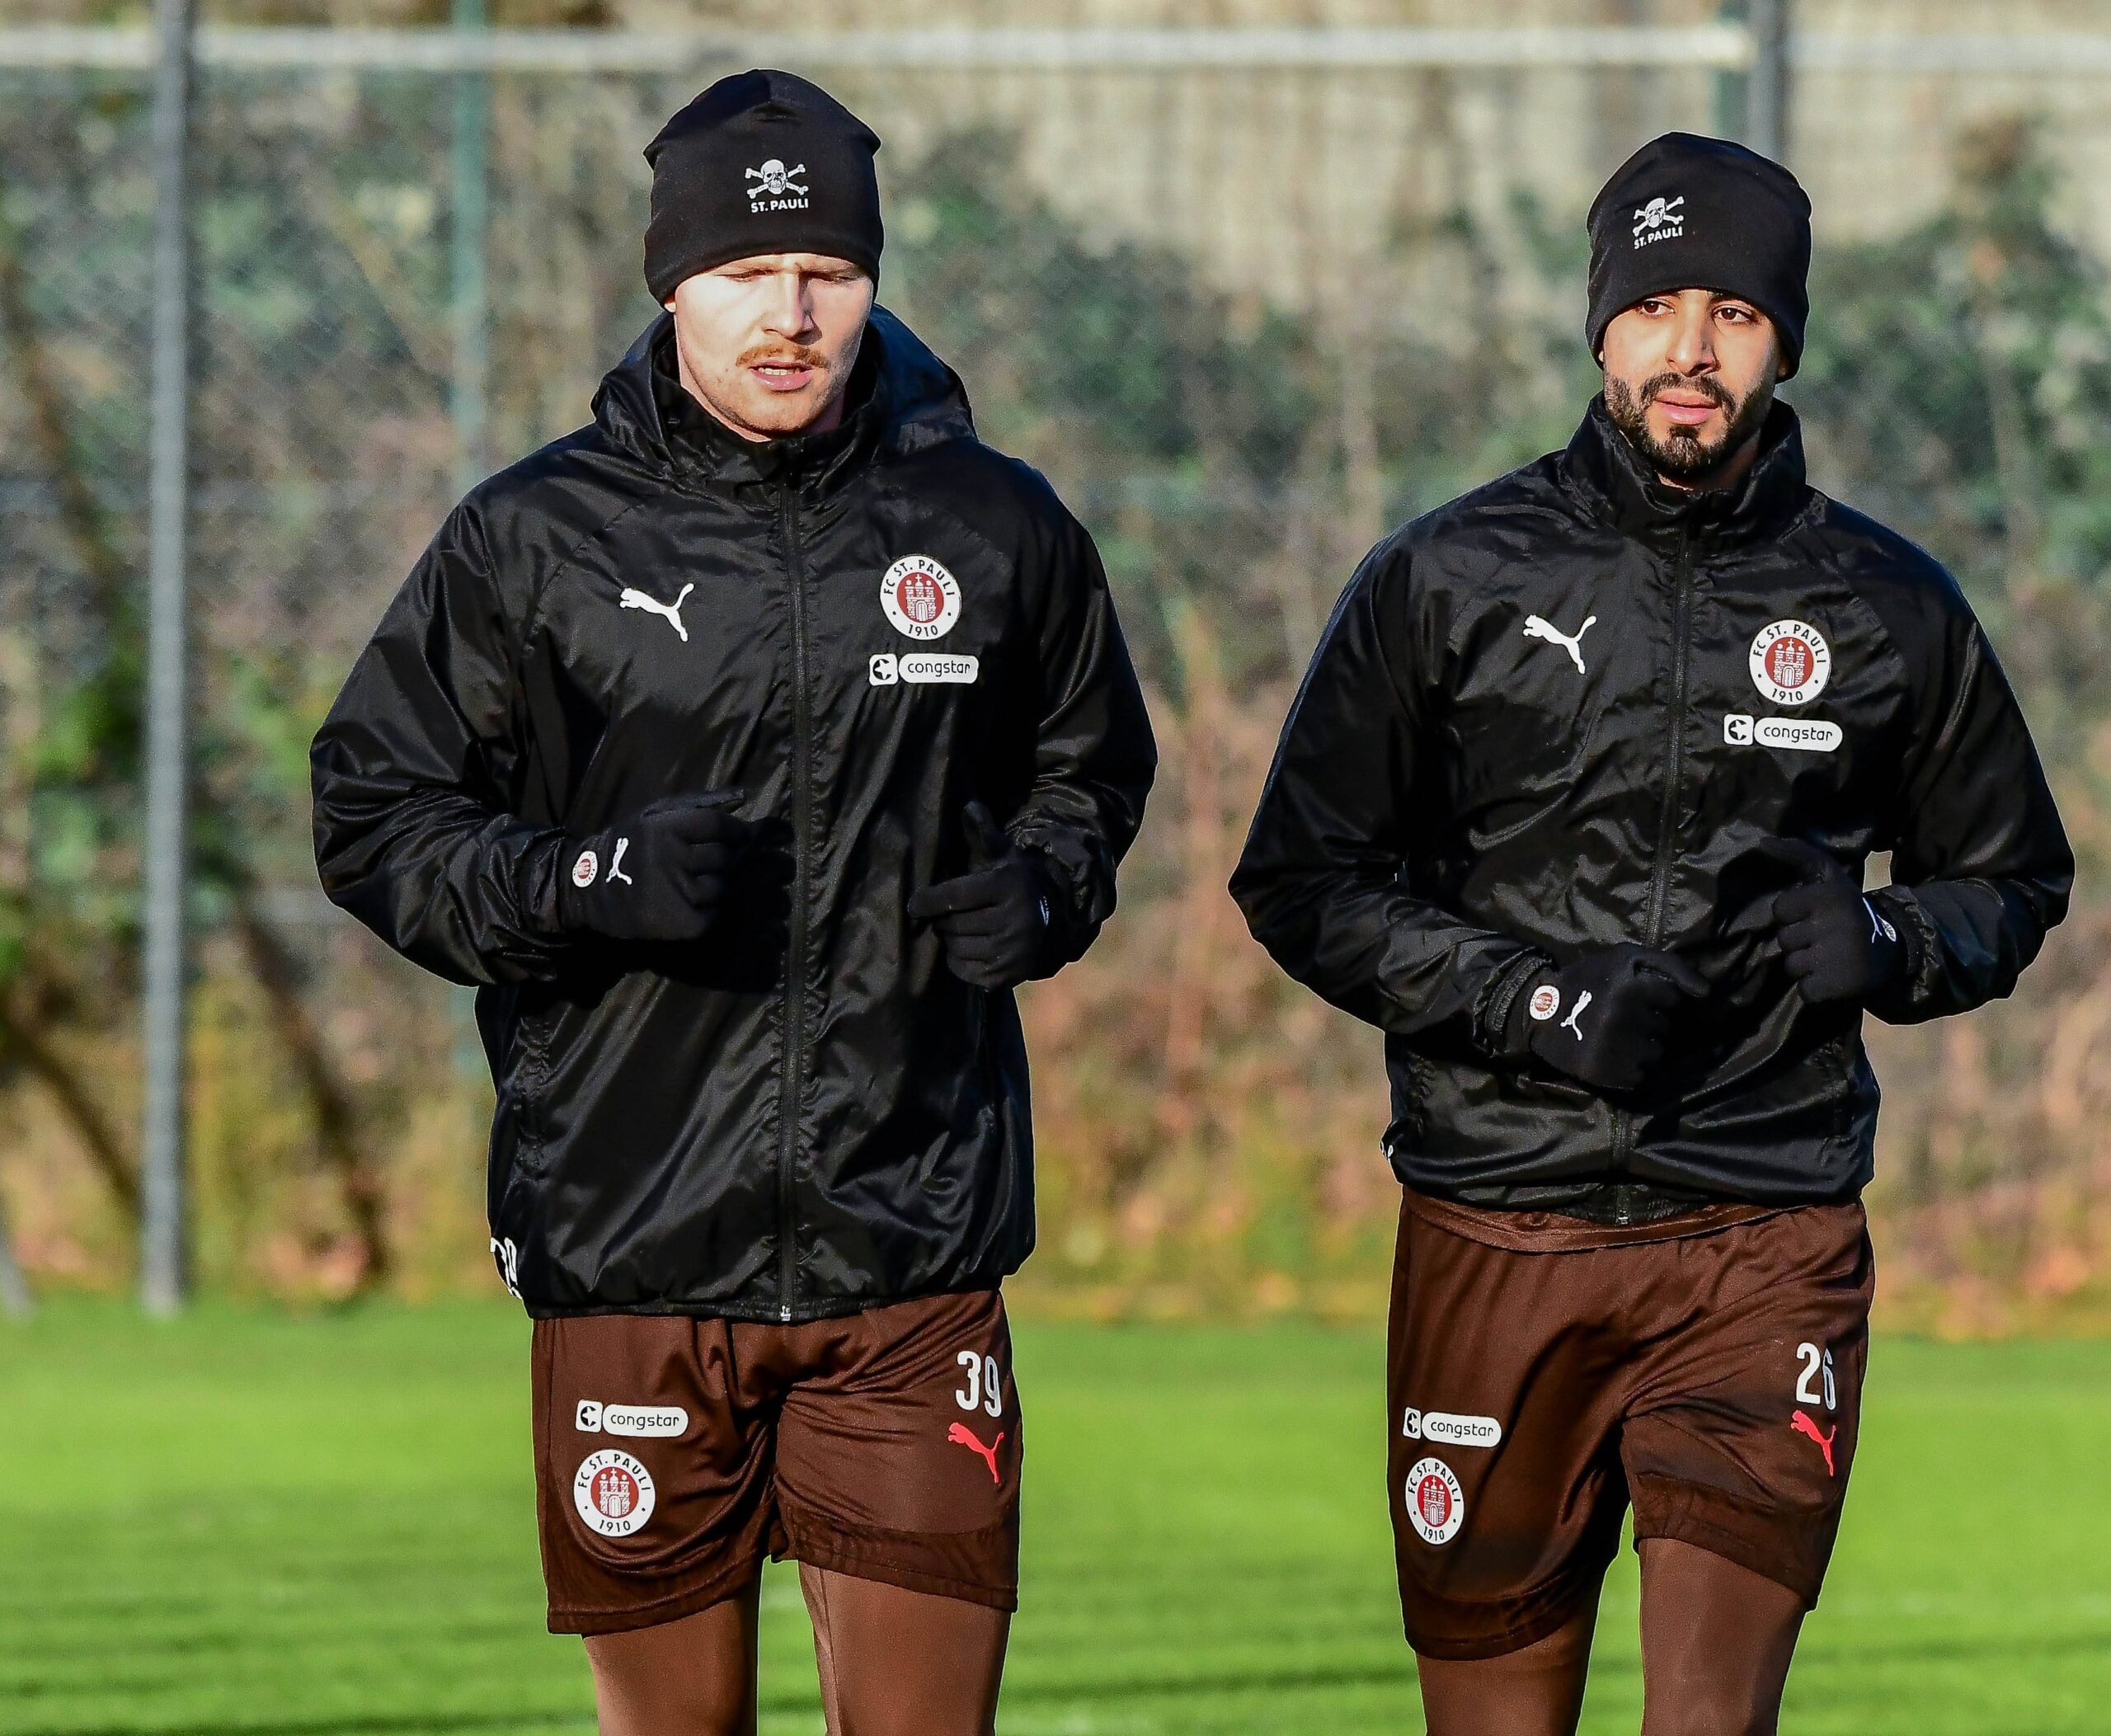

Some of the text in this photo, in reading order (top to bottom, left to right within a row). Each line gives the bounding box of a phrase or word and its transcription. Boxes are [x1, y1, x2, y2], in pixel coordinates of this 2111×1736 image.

[750, 198, 809, 213] ST. PAULI
[1634, 226, 1683, 250] ST. PAULI
[883, 559, 955, 595] FC ST. PAULI
[909, 624, 938, 637] 1910
[1753, 623, 1827, 663] FC ST. PAULI
[907, 661, 971, 677] congstar
[1771, 688, 1803, 702] 1910
[1763, 727, 1833, 743] congstar
[956, 1350, 1002, 1418] 39
[1796, 1342, 1836, 1410] 26
[610, 1414, 679, 1430] congstar
[1430, 1421, 1494, 1438] congstar
[577, 1453, 651, 1491] FC ST. PAULI
[1408, 1462, 1461, 1503] FC ST. PAULI
[599, 1519, 631, 1532] 1910
[1423, 1526, 1445, 1541] 1910
